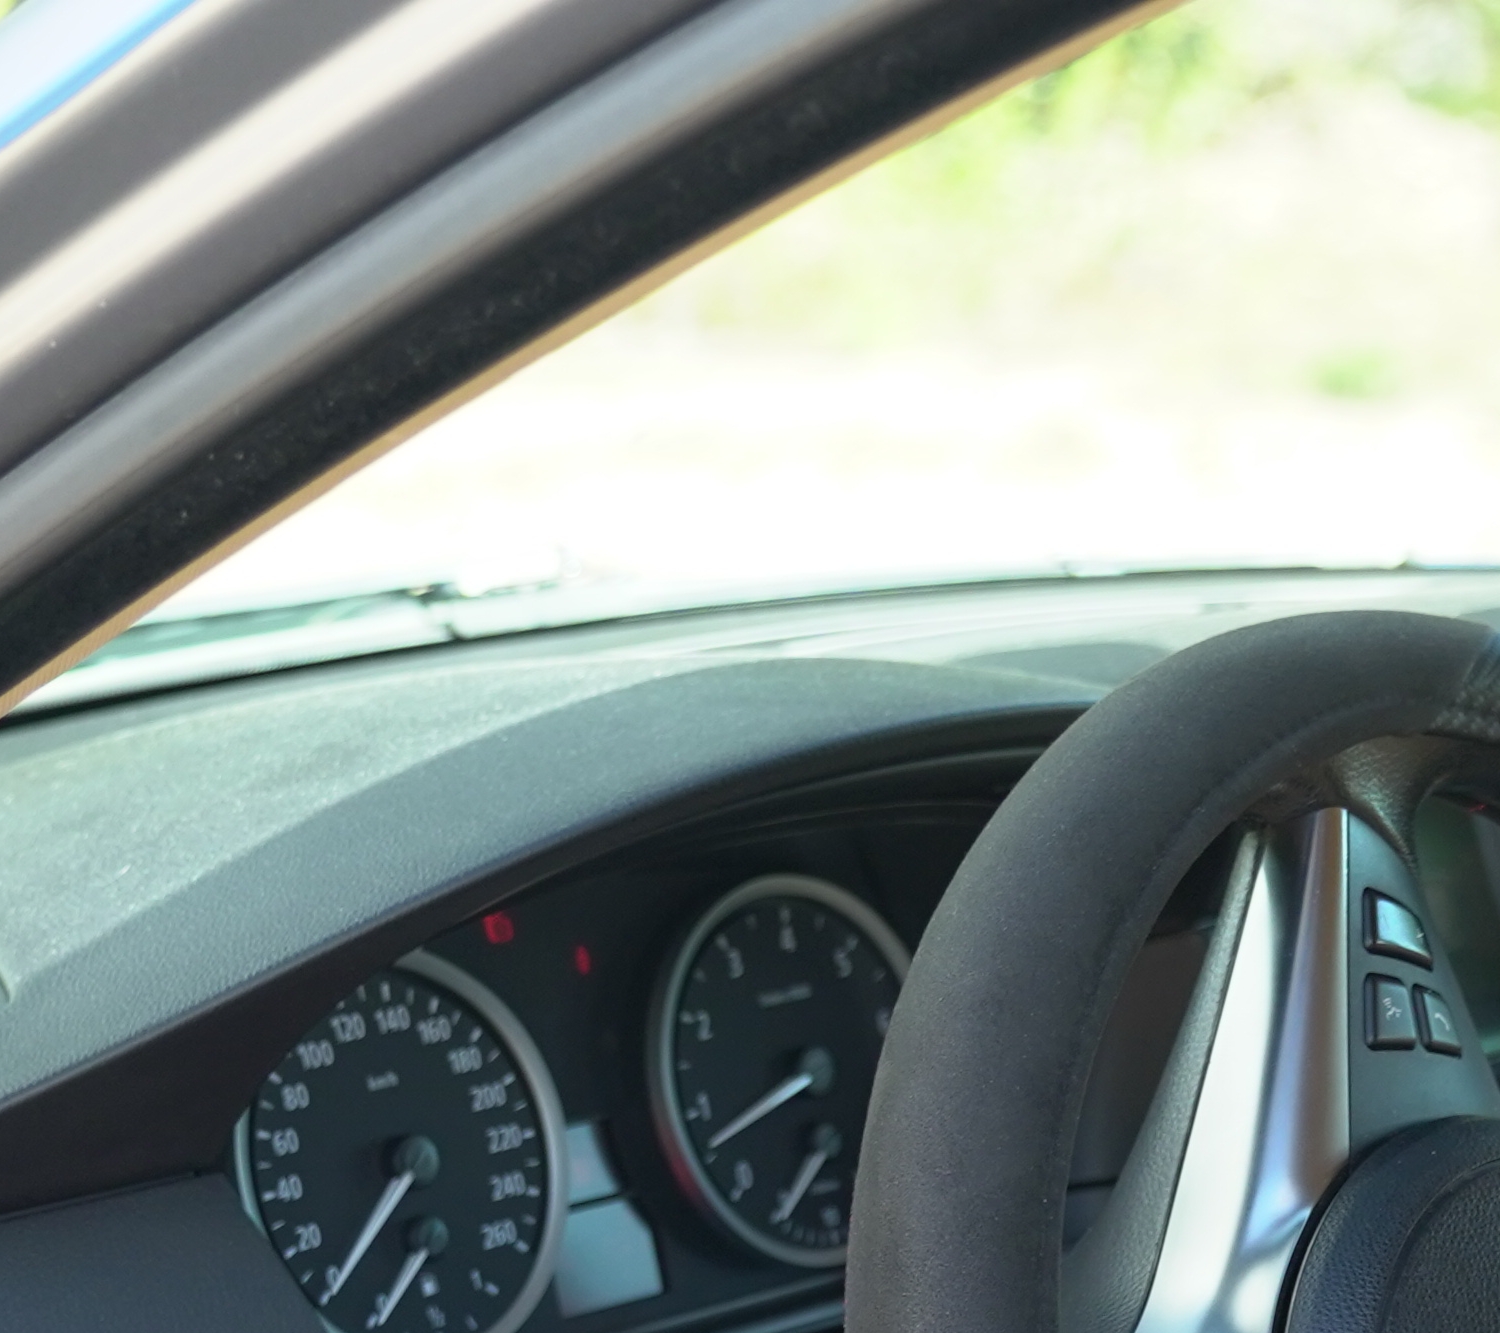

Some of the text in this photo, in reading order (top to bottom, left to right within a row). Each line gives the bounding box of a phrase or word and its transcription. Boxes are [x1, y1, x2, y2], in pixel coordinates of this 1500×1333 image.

[330, 1011, 366, 1043] 120
[374, 1004, 411, 1034] 140
[417, 1015, 451, 1046] 160
[296, 1039, 335, 1071] 100
[282, 1082, 310, 1112] 80
[469, 1080, 507, 1113] 200
[272, 1127, 300, 1157] 60
[485, 1123, 523, 1154] 220
[276, 1174, 303, 1202] 40
[295, 1222, 322, 1253] 20
[481, 1218, 518, 1250] 260
